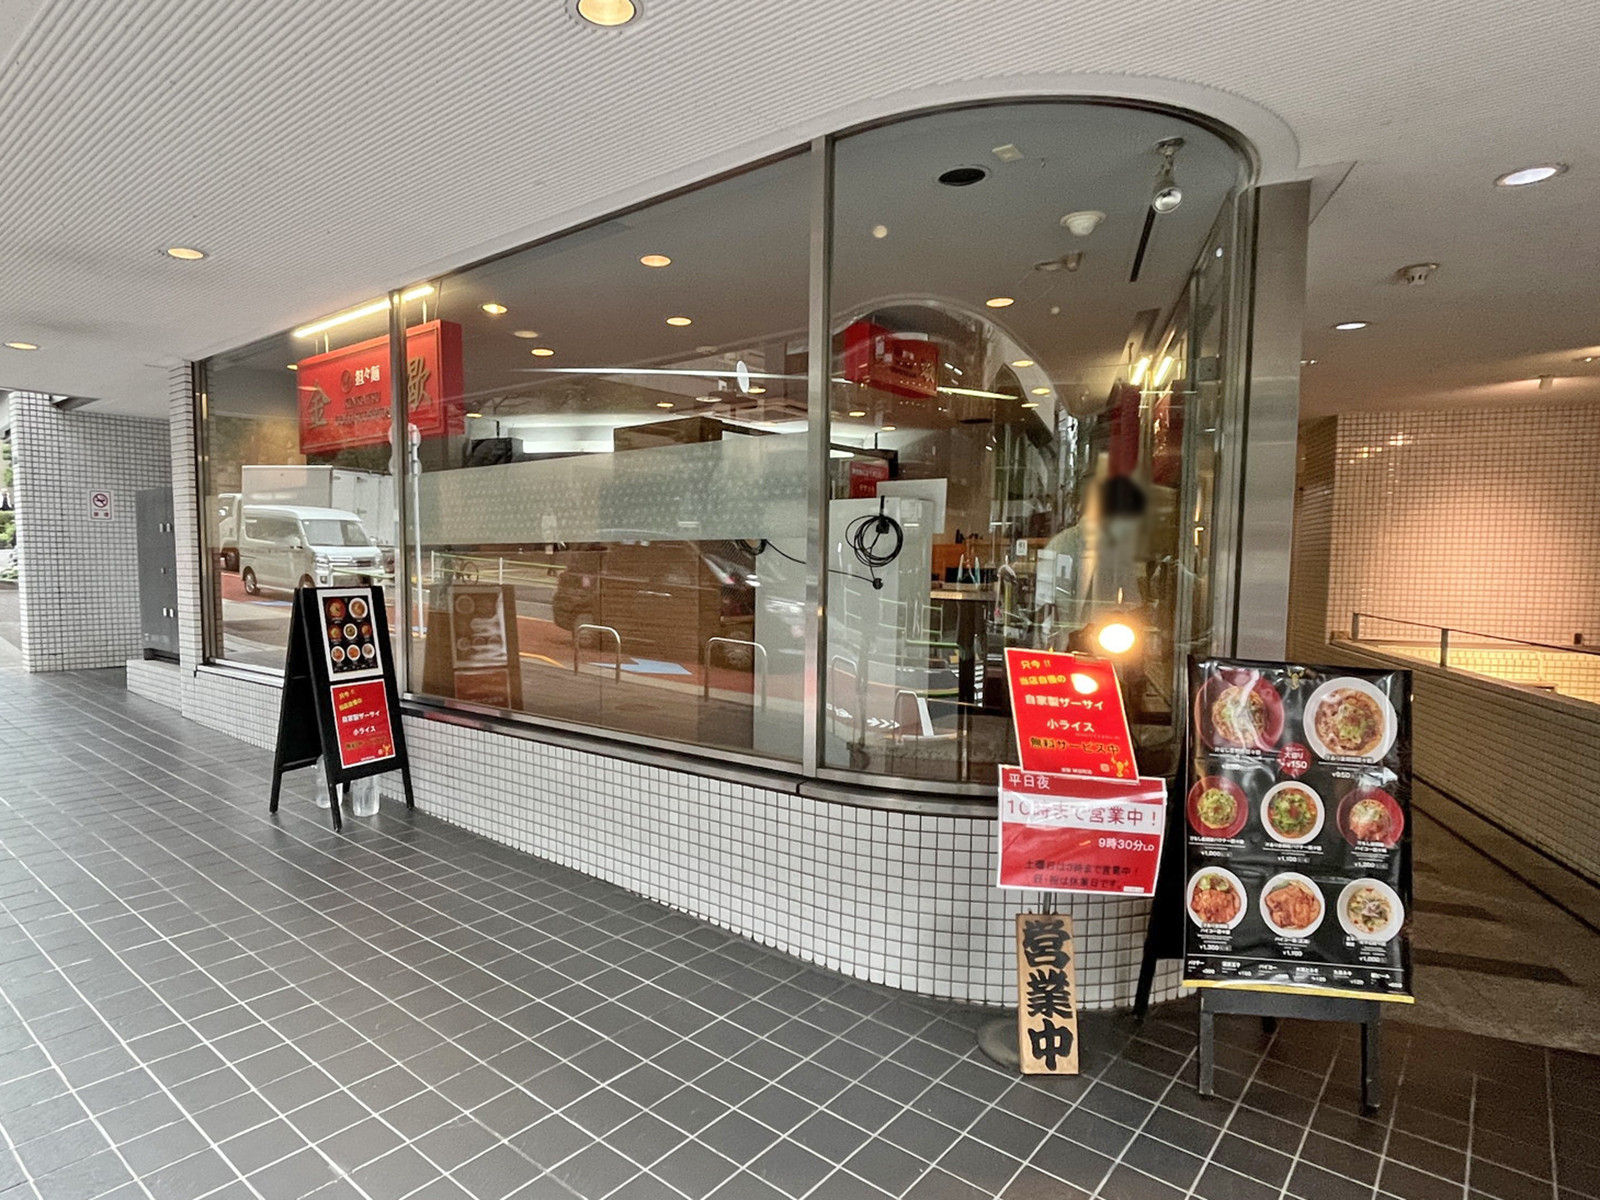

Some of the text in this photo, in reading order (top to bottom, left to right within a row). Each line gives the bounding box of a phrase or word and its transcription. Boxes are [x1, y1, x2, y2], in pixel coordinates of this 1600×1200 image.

[307, 380, 331, 429] 金
[1020, 660, 1041, 669] 只今
[1019, 675, 1067, 686] 当店自慢の
[1025, 694, 1104, 711] 自家製ザーサイ
[1047, 718, 1095, 733] 小ライス
[1029, 736, 1121, 756] 無料サービス中
[1286, 760, 1308, 769] ¥150
[1008, 773, 1050, 790] 平日夜
[1022, 919, 1074, 1071] 営業中
